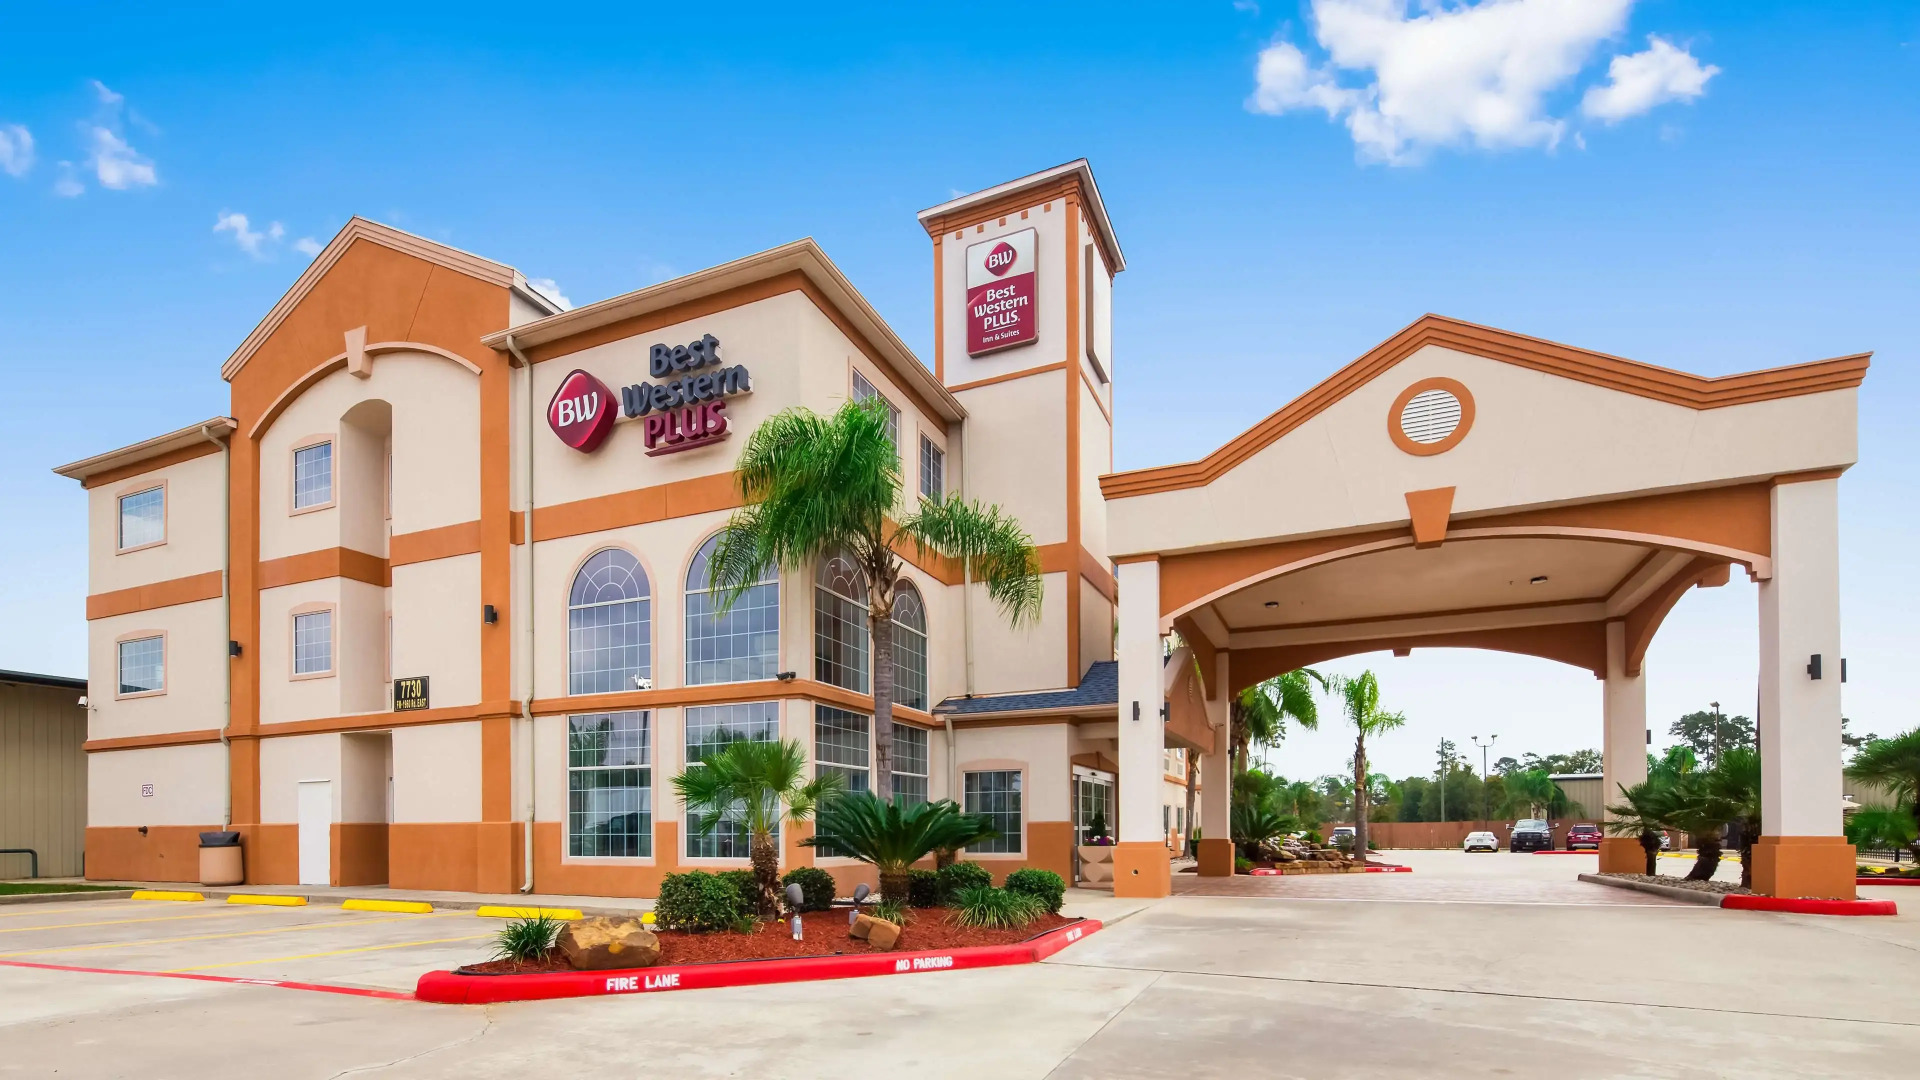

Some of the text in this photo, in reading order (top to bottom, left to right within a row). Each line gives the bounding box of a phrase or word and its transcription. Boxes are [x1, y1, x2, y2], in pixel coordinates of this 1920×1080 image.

[989, 249, 1013, 269] BW
[986, 284, 1016, 303] Best
[974, 295, 1029, 318] Western
[983, 309, 1018, 330] PLUS
[982, 329, 1020, 344] Inn & Suites
[650, 333, 722, 378] Best
[621, 364, 751, 418] Western
[557, 391, 598, 427] BW
[644, 400, 728, 449] PLUS
[400, 679, 421, 698] 7730
[896, 956, 953, 971] NO PARKING
[606, 973, 680, 991] FIRE LANE
